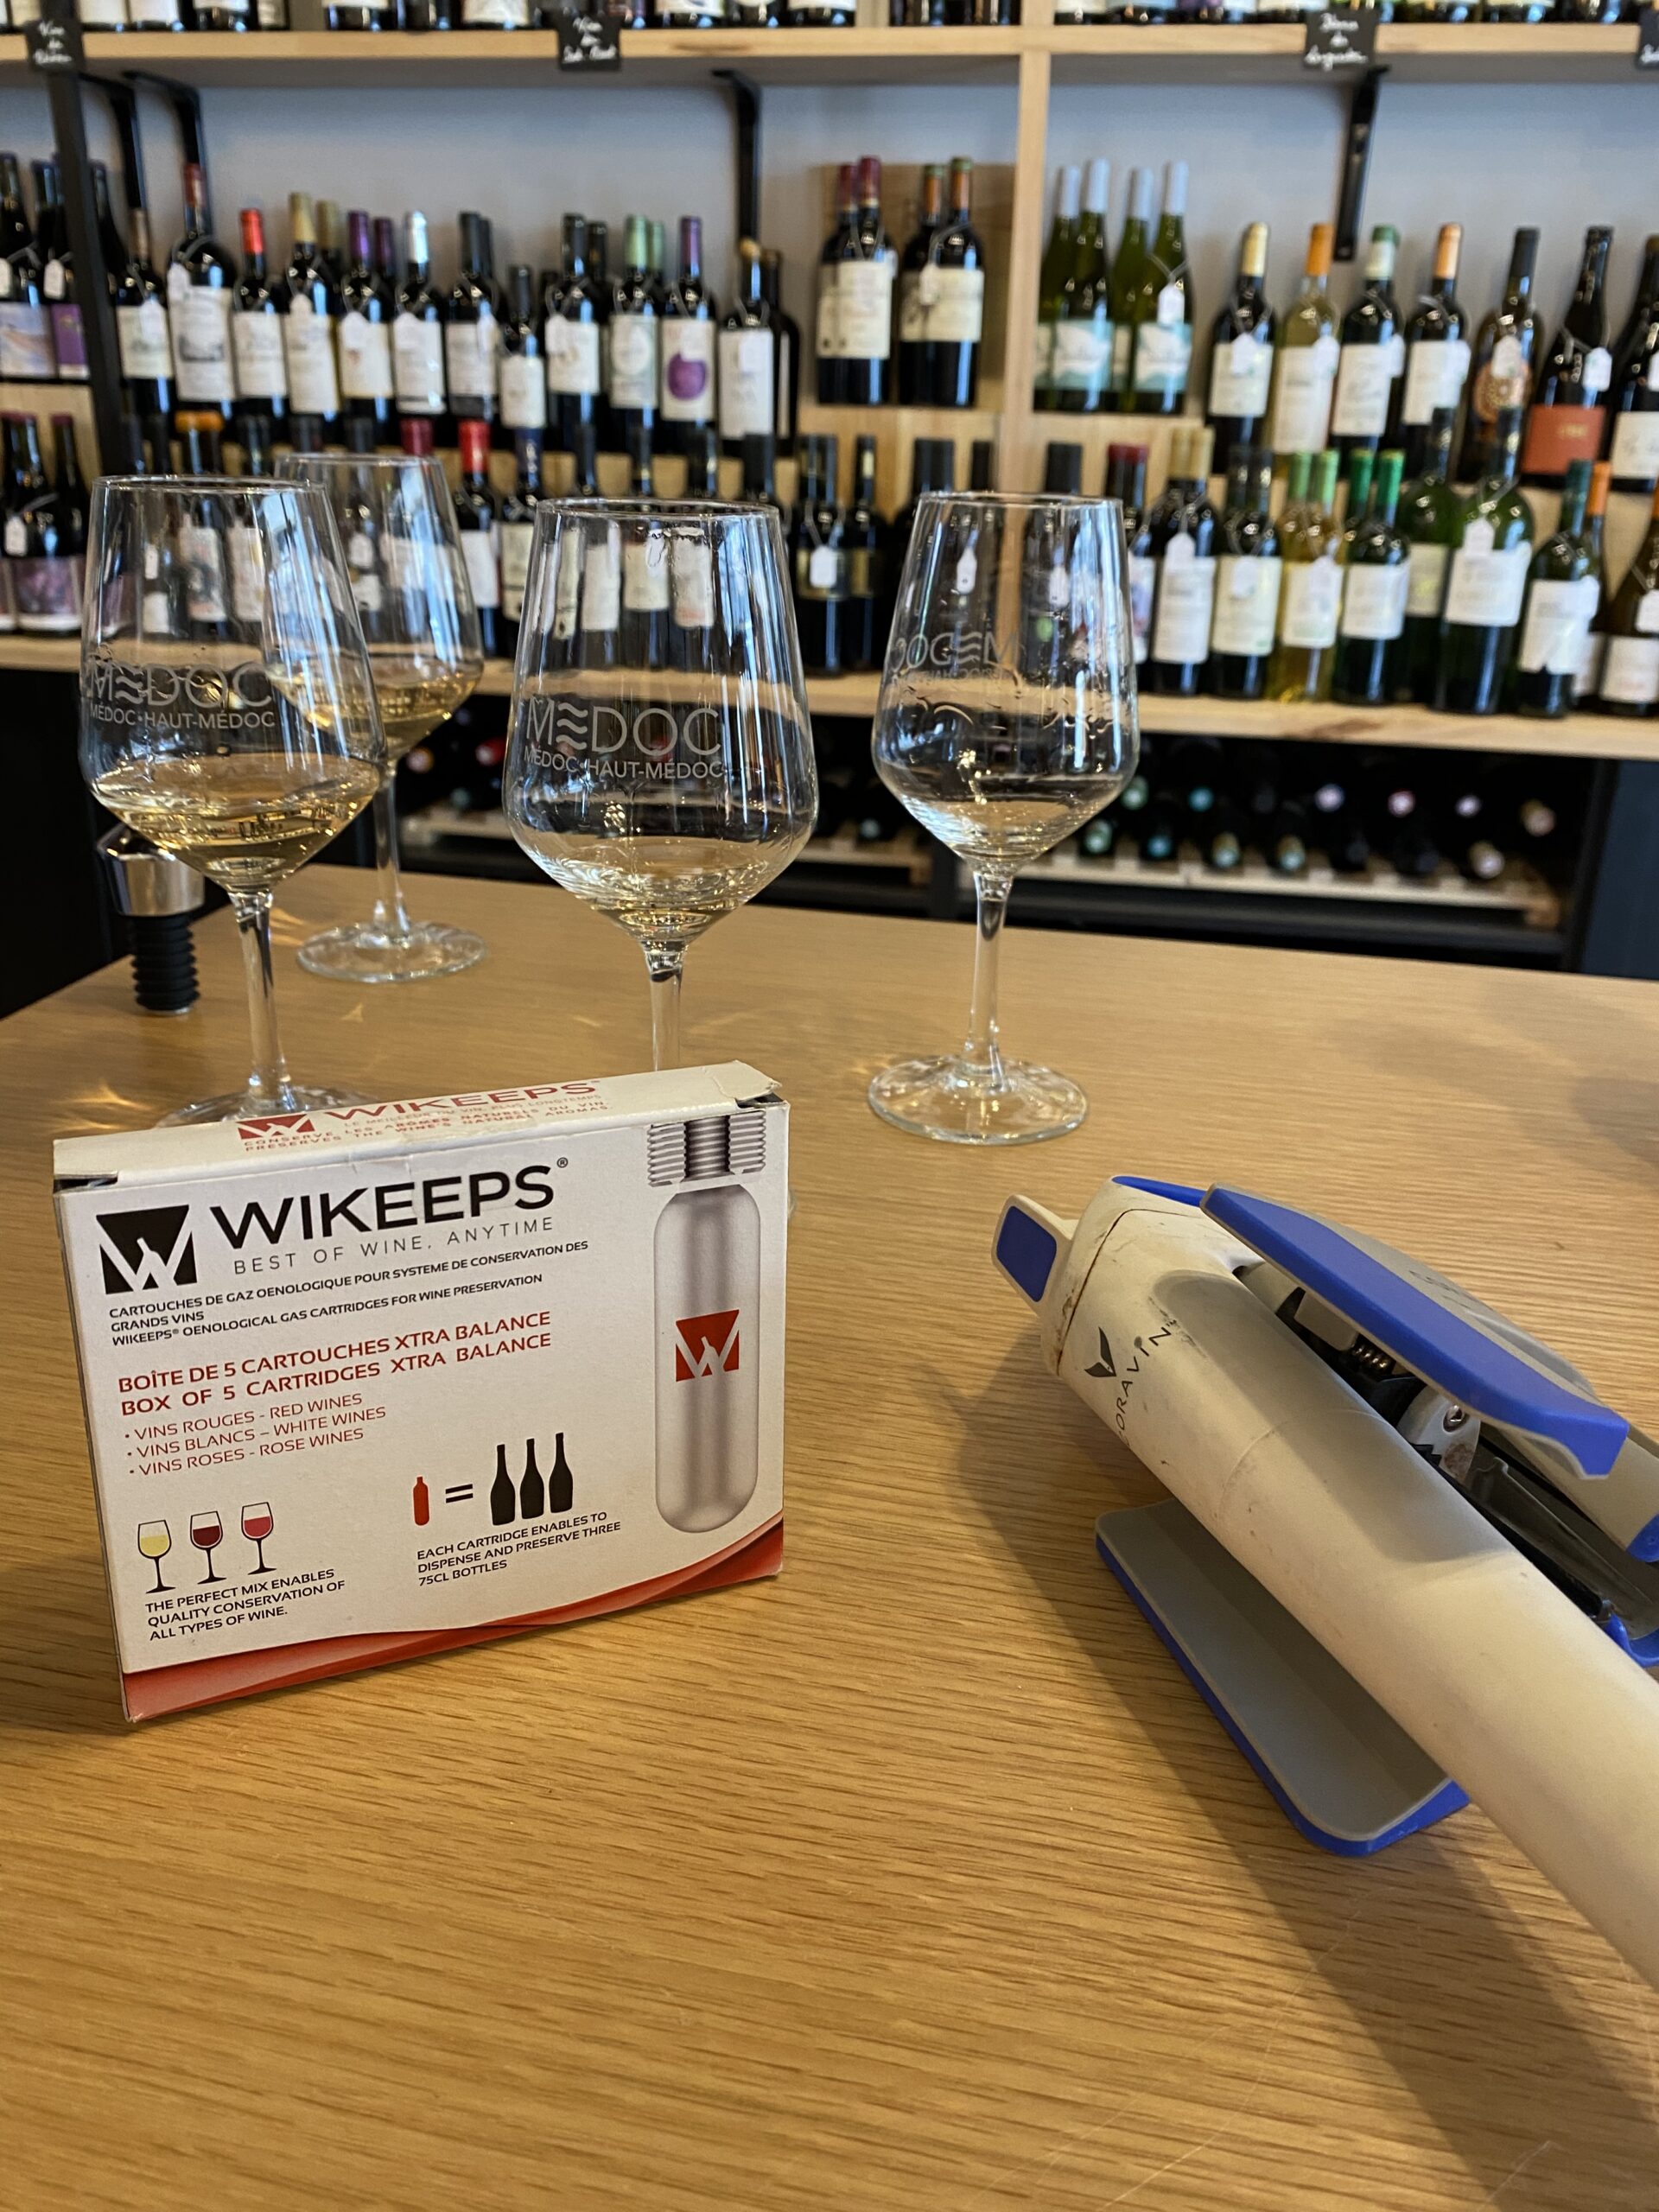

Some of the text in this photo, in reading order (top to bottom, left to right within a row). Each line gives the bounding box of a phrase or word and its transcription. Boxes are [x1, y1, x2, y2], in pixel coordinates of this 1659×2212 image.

[244, 1132, 334, 1147] CONSERVE
[245, 1136, 341, 1152] PRESERVES
[233, 1217, 553, 1275] BEST OF WINE, ANYTIME
[109, 1240, 588, 1319] CARTOUCHES DE GAZ OENOLOGIQUE POUR SYSTEME DE CONSERVATION DES
[111, 1311, 205, 1332] GRANDS VINS
[182, 1314, 278, 1337] OENOLOGICAL
[280, 1310, 308, 1322] GAS
[309, 1298, 390, 1319] CARTRIDGES
[391, 1294, 416, 1306] FOR
[418, 1287, 451, 1301] WINE
[453, 1274, 543, 1296] PRESERVATION
[118, 1311, 550, 1393] BOÎTE DE 5 CARTOUCHES XTRA BALANCE
[121, 1332, 551, 1416] BOX OF 5 CARTRIDGES XTRA BALANCE
[134, 1422, 178, 1440] VINS
[182, 1410, 255, 1433] ROUGES
[269, 1402, 304, 1419] RED
[308, 1393, 363, 1414] WINES
[137, 1440, 181, 1458] VINS
[185, 1428, 256, 1451] BLANCS
[273, 1416, 328, 1436] WHITE
[331, 1407, 386, 1427] WINES
[138, 1459, 182, 1476] VINS
[187, 1448, 245, 1469] ROSES
[259, 1438, 305, 1457] ROSE
[308, 1427, 364, 1448] WINES
[416, 1511, 607, 1560] EACH CARTRIDGE ENABLES TO
[417, 1521, 622, 1573] DISPENSE AND PRESERVE THREE
[145, 1568, 335, 1613] THE PERFECT MIX ENABLES
[418, 1559, 508, 1586] 75CL BOTTLES
[148, 1580, 346, 1628] QUALITY CONSERVATION OF
[149, 1605, 289, 1641] ALL TYPES OF WINE.
